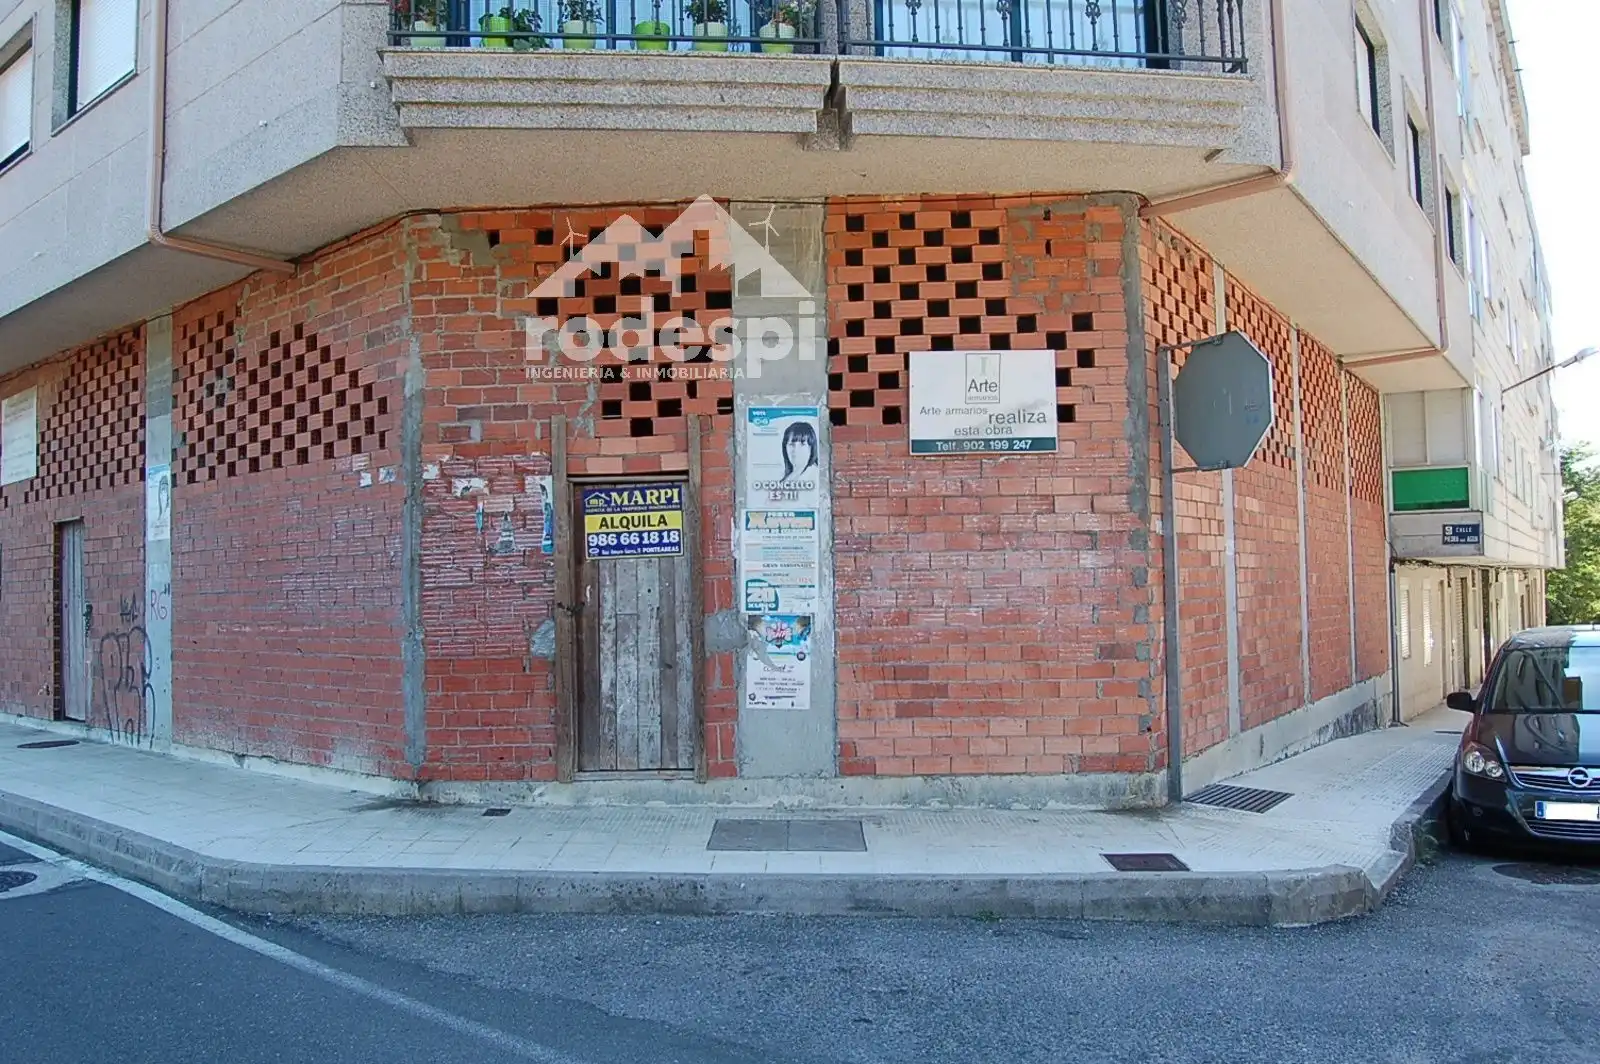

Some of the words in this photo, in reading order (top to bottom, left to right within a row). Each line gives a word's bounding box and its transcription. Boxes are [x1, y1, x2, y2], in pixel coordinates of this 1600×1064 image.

[967, 378, 998, 393] Arte
[919, 406, 942, 416] Arte
[945, 405, 988, 415] armarios
[988, 408, 1047, 425] realiza
[954, 425, 980, 436] esta
[985, 424, 1013, 435] obra
[936, 441, 960, 451] Telf.
[963, 441, 985, 450] 902
[990, 440, 1009, 450] 199
[1013, 439, 1032, 449] 247
[762, 481, 814, 491] CONCELLO
[609, 488, 680, 506] MARPI
[598, 514, 668, 530] ALQUILA
[588, 533, 618, 547] 986
[619, 532, 640, 545] 66
[641, 531, 660, 544] 18
[661, 530, 680, 543] 18
